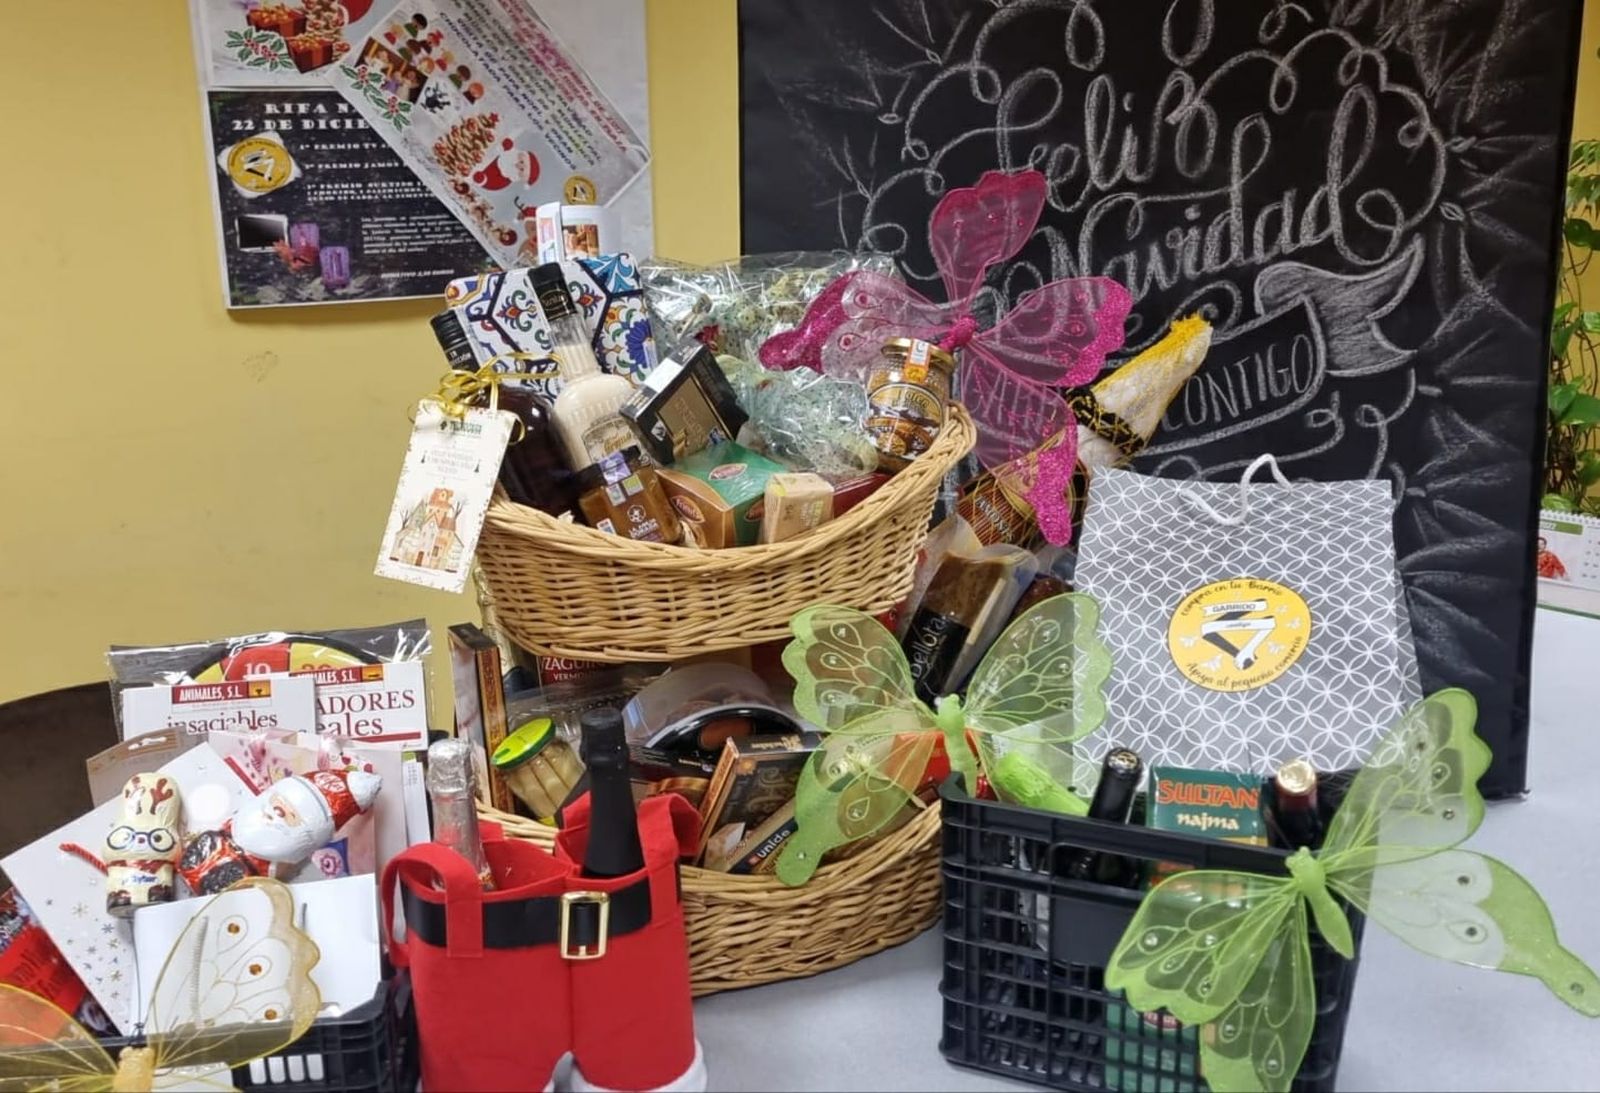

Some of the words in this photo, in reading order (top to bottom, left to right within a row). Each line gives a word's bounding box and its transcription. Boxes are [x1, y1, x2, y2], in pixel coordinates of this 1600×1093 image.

[264, 103, 328, 114] RIFA
[336, 103, 356, 114] N
[231, 120, 255, 130] 22
[264, 119, 292, 130] DE
[301, 119, 371, 130] DICIE
[1004, 84, 1405, 345] Navidad
[1212, 603, 1256, 612] GARRIDO
[179, 686, 225, 702] ANIMALES,
[315, 690, 415, 715] ADORES
[316, 712, 384, 737] eales
[1157, 779, 1260, 810] SULTAN
[1177, 812, 1240, 831] najma
[756, 829, 791, 859] unide
